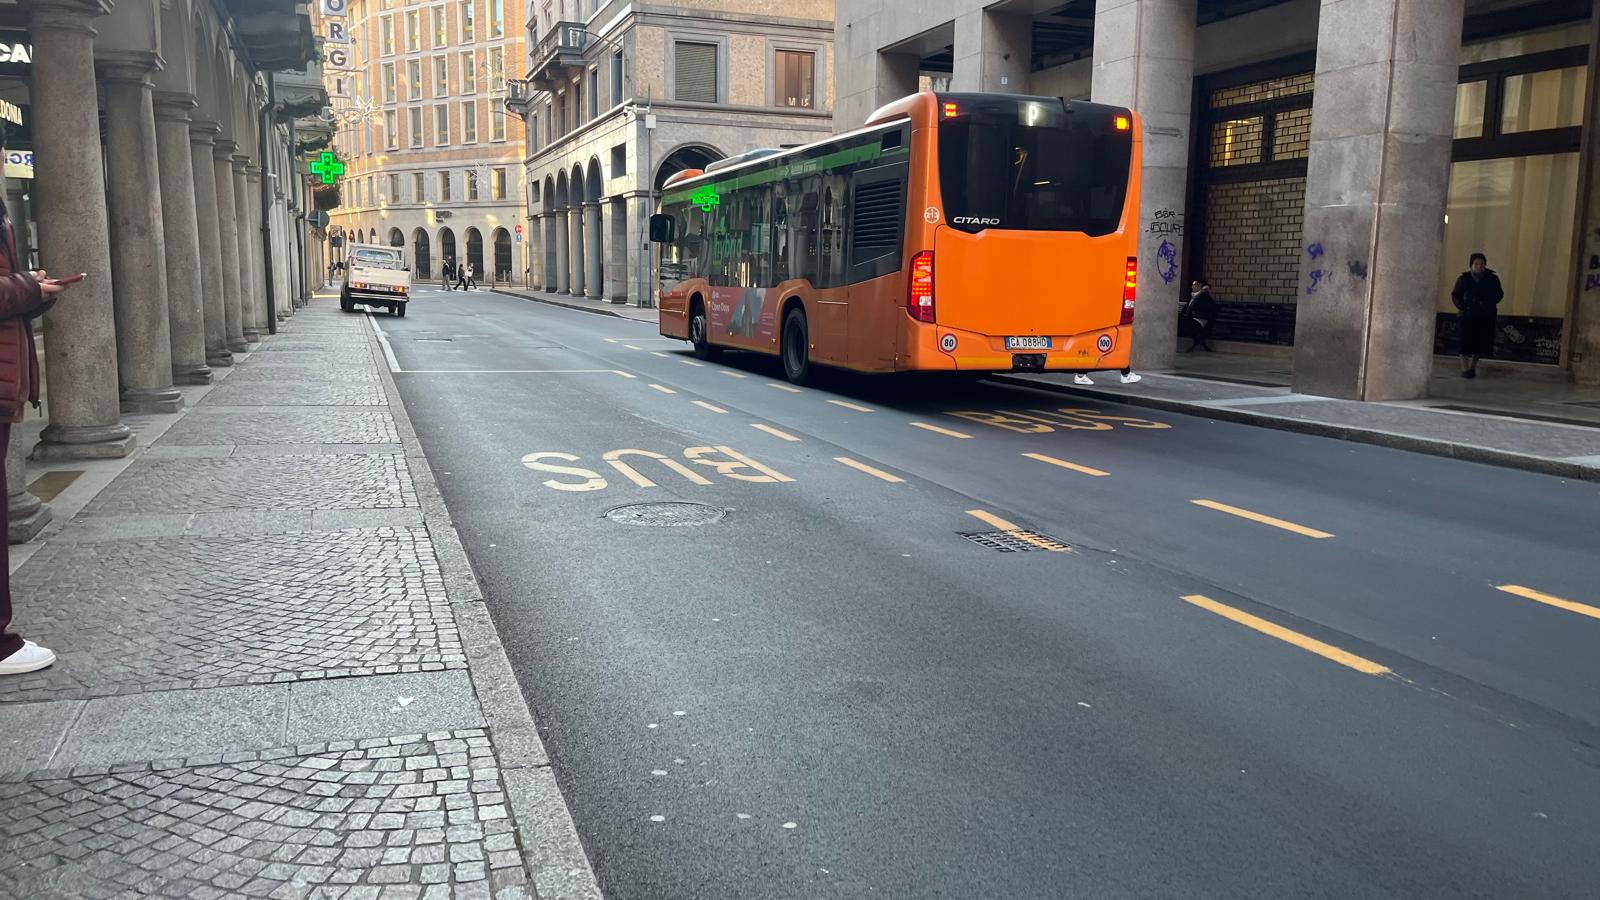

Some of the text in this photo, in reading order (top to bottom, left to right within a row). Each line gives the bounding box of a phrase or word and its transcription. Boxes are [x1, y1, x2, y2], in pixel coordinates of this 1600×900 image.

[0, 43, 33, 64] CA
[0, 98, 23, 126] DONIA
[953, 216, 1001, 225] CITARO
[944, 339, 954, 347] 80
[1100, 339, 1110, 347] 100
[521, 445, 797, 492] BUS
